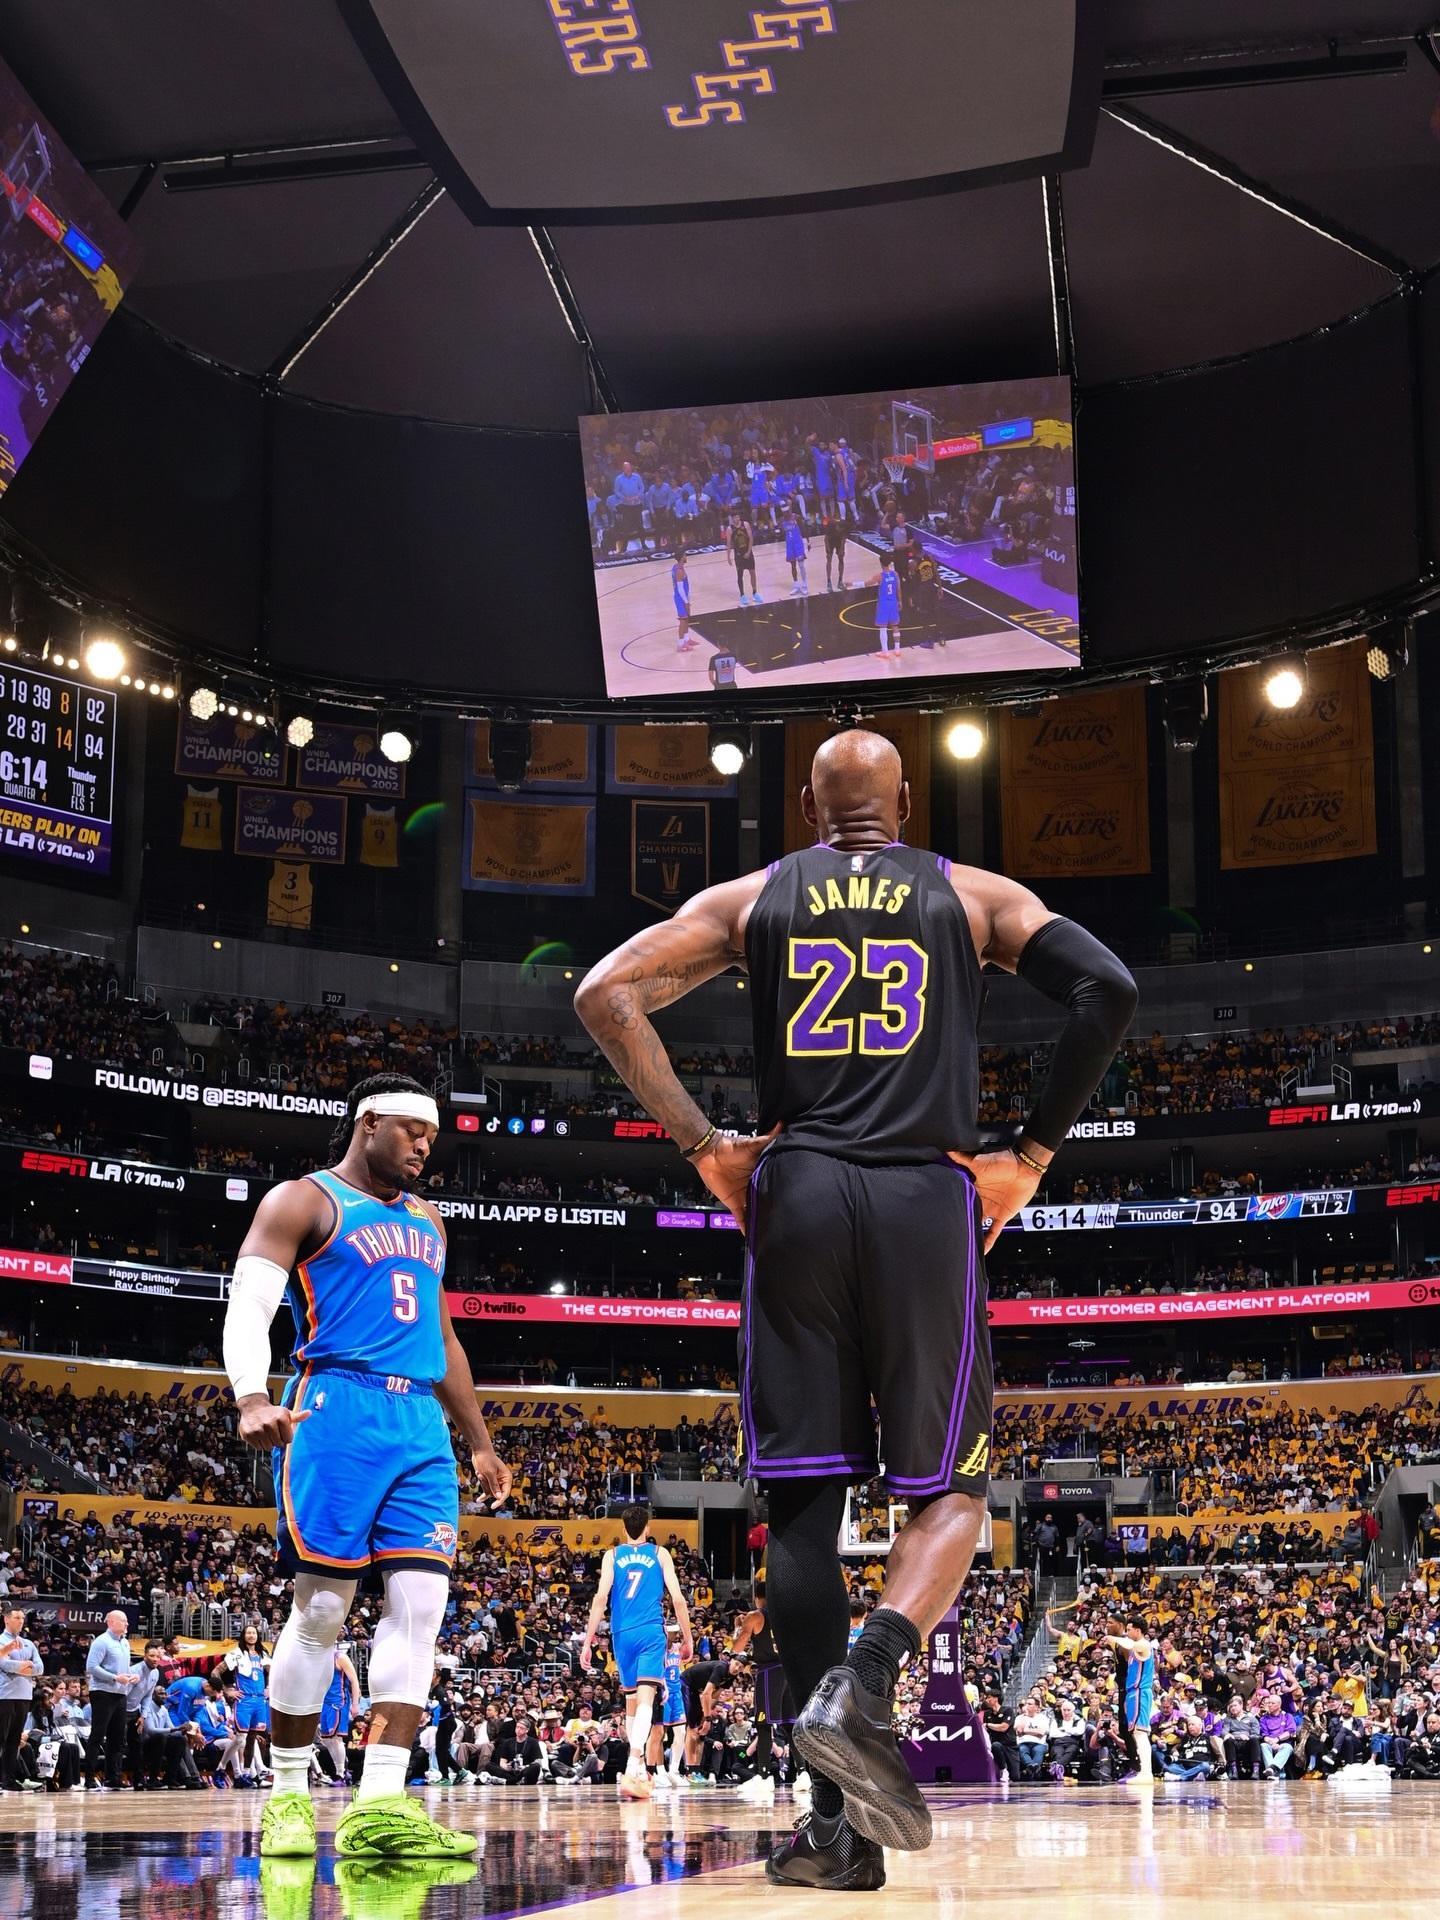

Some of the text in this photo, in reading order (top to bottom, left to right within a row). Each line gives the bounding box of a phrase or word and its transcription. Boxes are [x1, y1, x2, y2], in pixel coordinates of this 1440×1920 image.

[663, 0, 836, 127] ELES
[651, 544, 727, 560] Gogle
[11, 679, 28, 703] 19
[33, 685, 51, 710] 39
[60, 692, 70, 714] 8
[86, 698, 105, 724] 92
[7, 714, 104, 760] 28 31 14 94
[185, 735, 210, 746] WNBA
[1033, 719, 1116, 747] LAKERS
[183, 743, 280, 767] CHAMPIONS
[306, 749, 331, 759] WNBA
[0, 751, 47, 790] 6:14
[67, 766, 97, 784] Thunder
[252, 766, 279, 778] 2001
[304, 758, 399, 779] CHAMPIONS
[526, 757, 575, 776] HAMPIONS
[628, 760, 661, 780] WORLD
[4, 782, 36, 801] QUARTER
[71, 782, 96, 799] TOL 2
[371, 780, 400, 791] 2002
[71, 796, 94, 813] FLS 1
[1255, 797, 1344, 828] LAKERS
[192, 810, 211, 830] 11
[244, 815, 269, 825] WNBA
[1031, 813, 1120, 841] LAKERS
[5, 829, 36, 850] LA
[35, 818, 76, 840] PLAY
[78, 828, 101, 846] ON
[242, 824, 339, 845] CHAMPIONS
[374, 828, 386, 844] 9
[311, 846, 337, 856] 2016
[638, 845, 704, 855] CHAMPIONS
[484, 856, 572, 880] WORLD CHAMPIONS
[284, 872, 298, 890] 3
[808, 876, 911, 916] JAMES
[787, 937, 928, 1057] 23
[1217, 1009, 1233, 1018] 310
[95, 1069, 348, 1117] FOLLOW US @ESPNLOSANG
[1269, 1106, 1328, 1125] ESPN
[1331, 1103, 1360, 1120] LA
[1065, 1121, 1136, 1138] NGELES
[22, 1152, 87, 1176] ESPN
[89, 1162, 122, 1182] LA
[1210, 1203, 1237, 1220] 94
[1258, 1194, 1287, 1215] OKC
[1312, 1204, 1318, 1214] 1
[1334, 1201, 1343, 1213] 2
[479, 1203, 500, 1221] LA
[503, 1205, 541, 1221] APP
[544, 1207, 558, 1223] &
[561, 1207, 626, 1226] LISTEN
[1032, 1208, 1086, 1229] 6:14
[1097, 1212, 1116, 1227] 4th
[1128, 1208, 1184, 1222] Thunder
[344, 1223, 446, 1274] THUNDER
[34, 1260, 72, 1276] PLA
[108, 1268, 180, 1286] Happy Birthday
[114, 1280, 173, 1295] Ray Castillo!
[391, 1271, 419, 1323] 5
[1029, 1291, 1370, 1318] THE CUSTOMER ENGAGEMENT PLATFORM
[484, 1301, 526, 1314] twilio
[562, 1303, 596, 1316] THE
[599, 1305, 687, 1319] CUSTOMER
[386, 1375, 412, 1394] OKC
[1113, 1396, 1265, 1418] LAKERS
[144, 1511, 168, 1519] LOS
[627, 1571, 642, 1599] 7
[935, 1634, 949, 1646] GET
[936, 1647, 950, 1658] THE
[252, 1672, 258, 1681] 6
[669, 1669, 676, 1680] 2
[940, 1660, 954, 1675] App
[931, 1703, 955, 1711] Google
